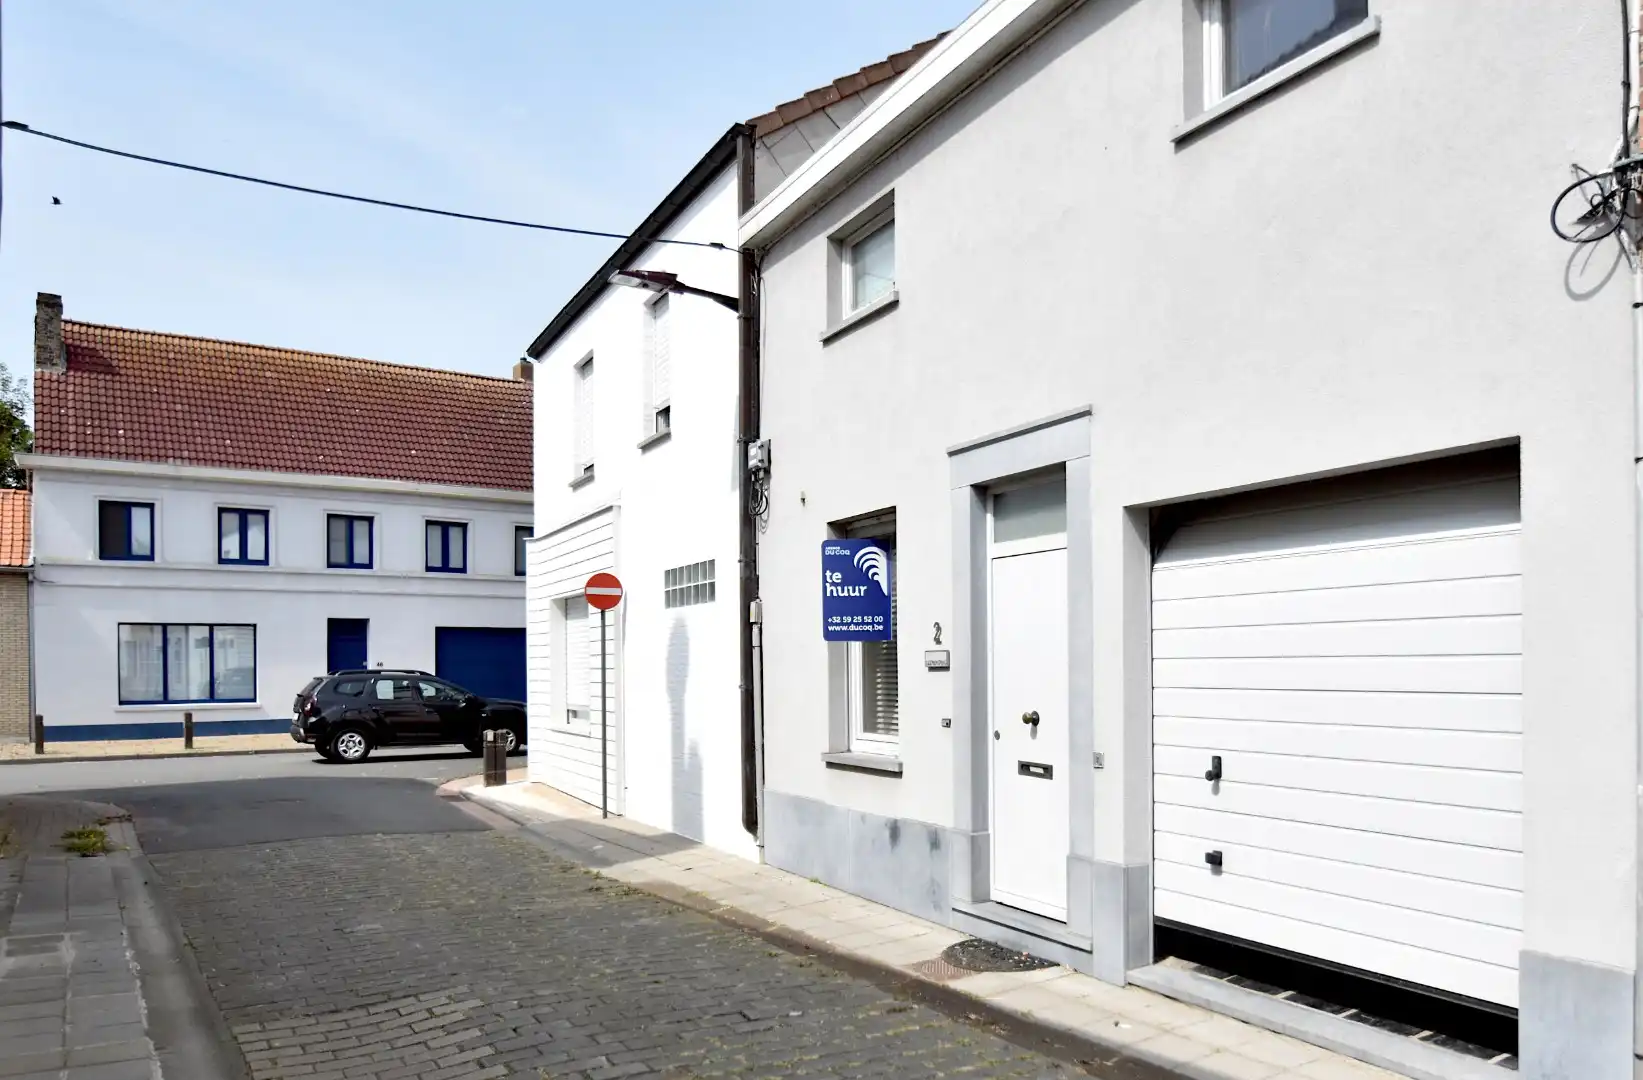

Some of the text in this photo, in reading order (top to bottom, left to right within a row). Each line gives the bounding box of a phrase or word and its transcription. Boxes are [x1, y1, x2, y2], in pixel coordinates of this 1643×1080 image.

[825, 570, 842, 582] te
[825, 583, 867, 596] huur
[933, 622, 942, 645] 2
